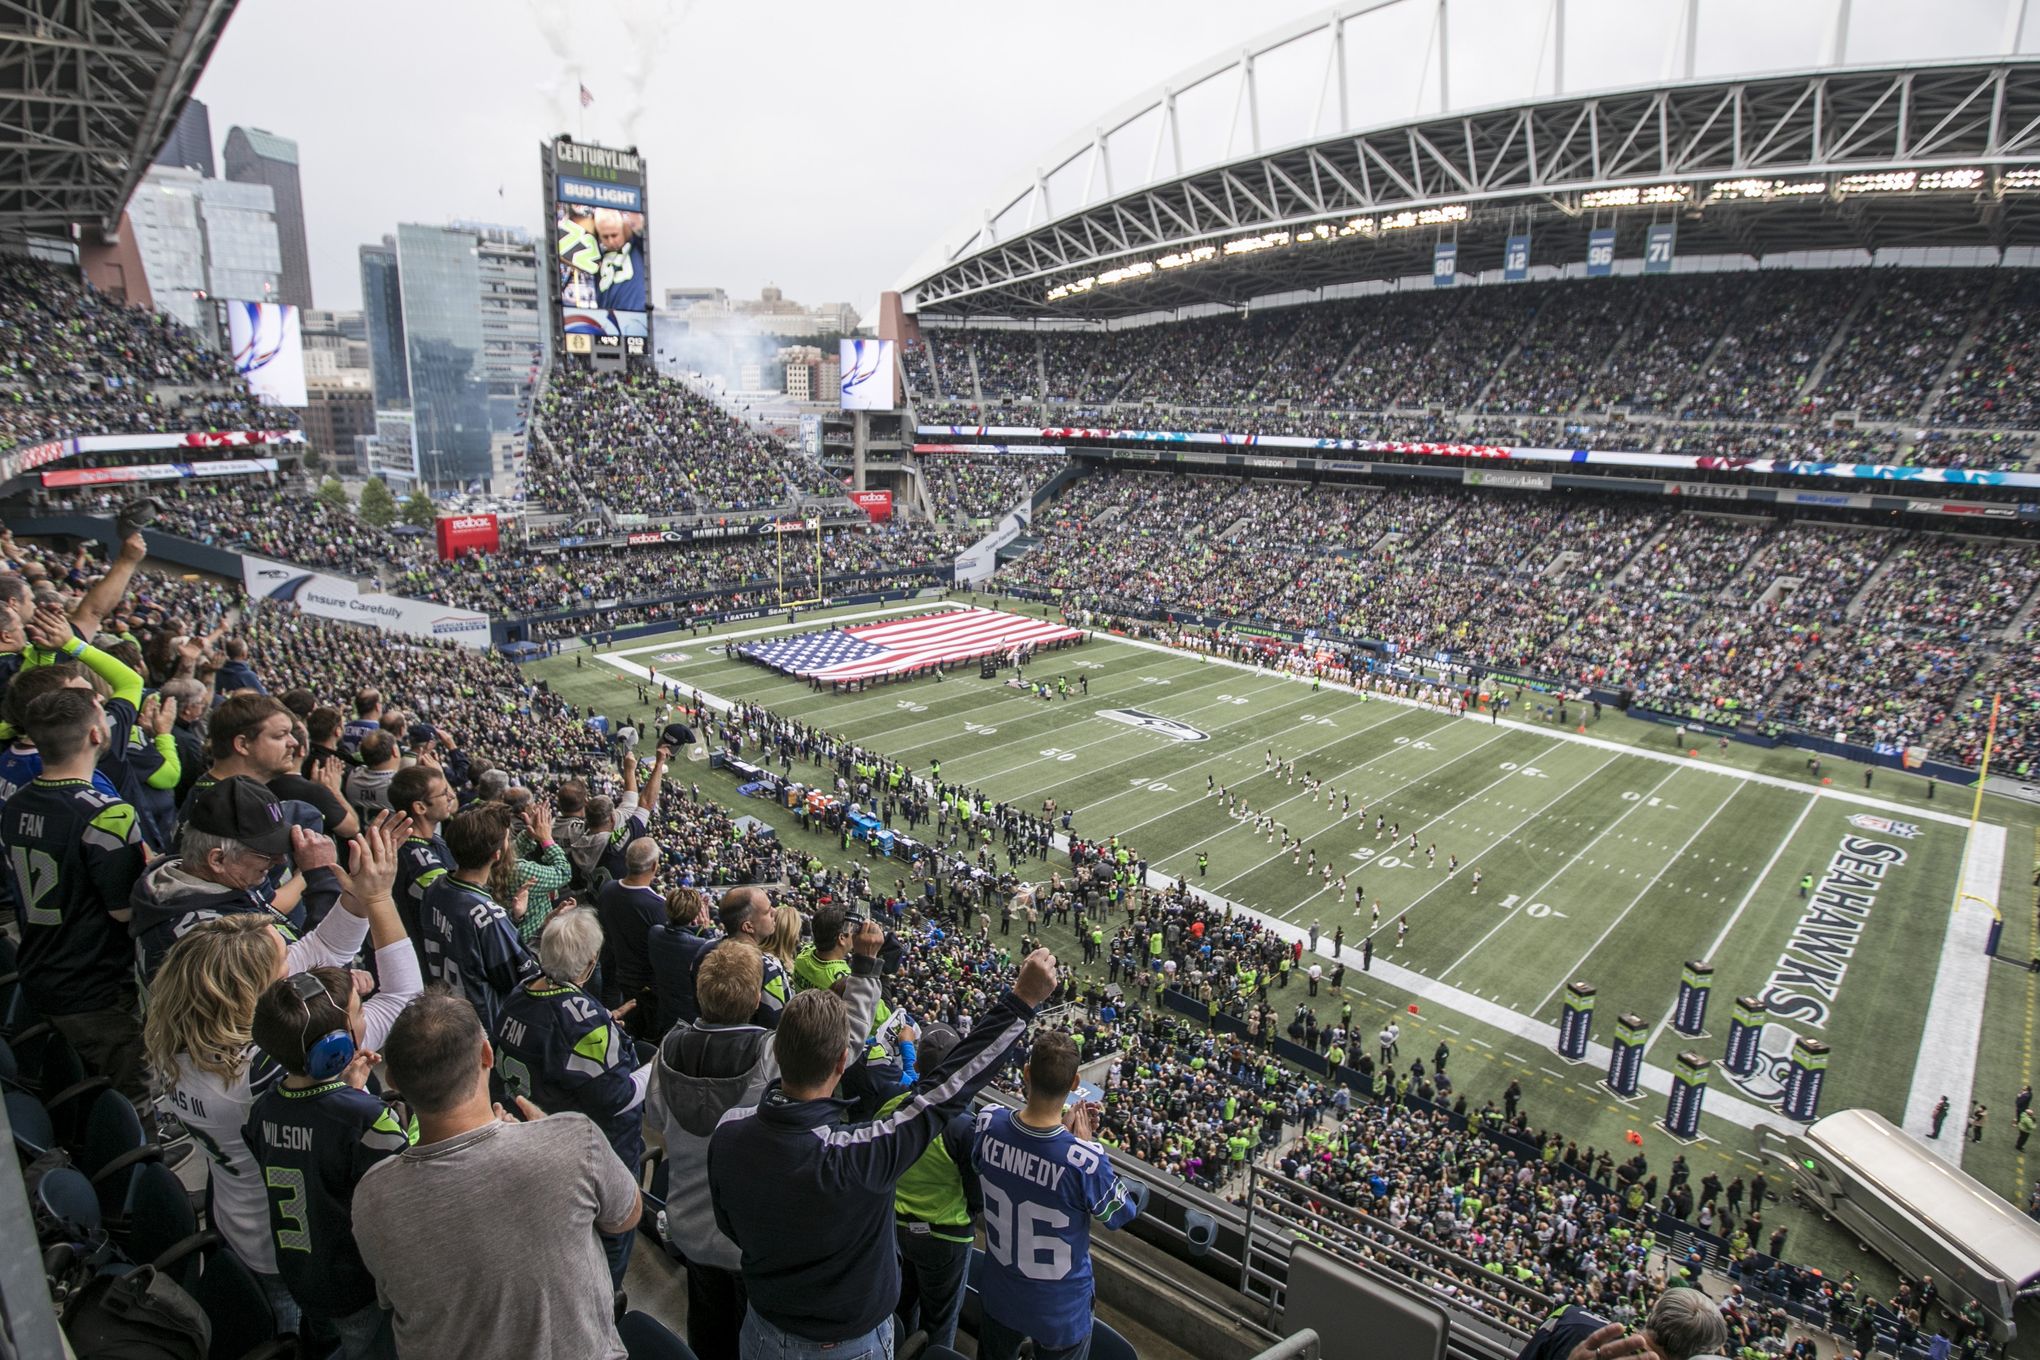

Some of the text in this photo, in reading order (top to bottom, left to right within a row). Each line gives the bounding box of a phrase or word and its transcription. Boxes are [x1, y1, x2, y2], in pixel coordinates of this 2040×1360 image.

[557, 140, 640, 173] CENTURYLINK
[583, 163, 618, 182] FIELD
[563, 182, 636, 206] BUD LIGHT
[1507, 251, 1526, 271] 12
[1588, 245, 1614, 267] 96
[1648, 241, 1671, 264] 71
[1434, 258, 1455, 277] 80
[1252, 458, 1284, 468] verizon
[1484, 473, 1545, 487] CenturyLink
[1687, 484, 1741, 498] DELTA
[692, 525, 750, 539] HAWKS NEST
[306, 591, 404, 620] Insure Carefully
[359, 789, 377, 802] FAN
[18, 812, 46, 839] FAN
[410, 847, 442, 867] 12
[10, 844, 64, 926] 12
[1757, 833, 1909, 1031] SEAHAWKS
[561, 996, 599, 1023] 12
[499, 1015, 528, 1048] FAN
[190, 1095, 208, 1119] III
[262, 1119, 314, 1152] WILSON
[981, 1135, 1066, 1192] KENNEDY
[265, 1166, 312, 1254] 3
[979, 1173, 1072, 1281] 96
